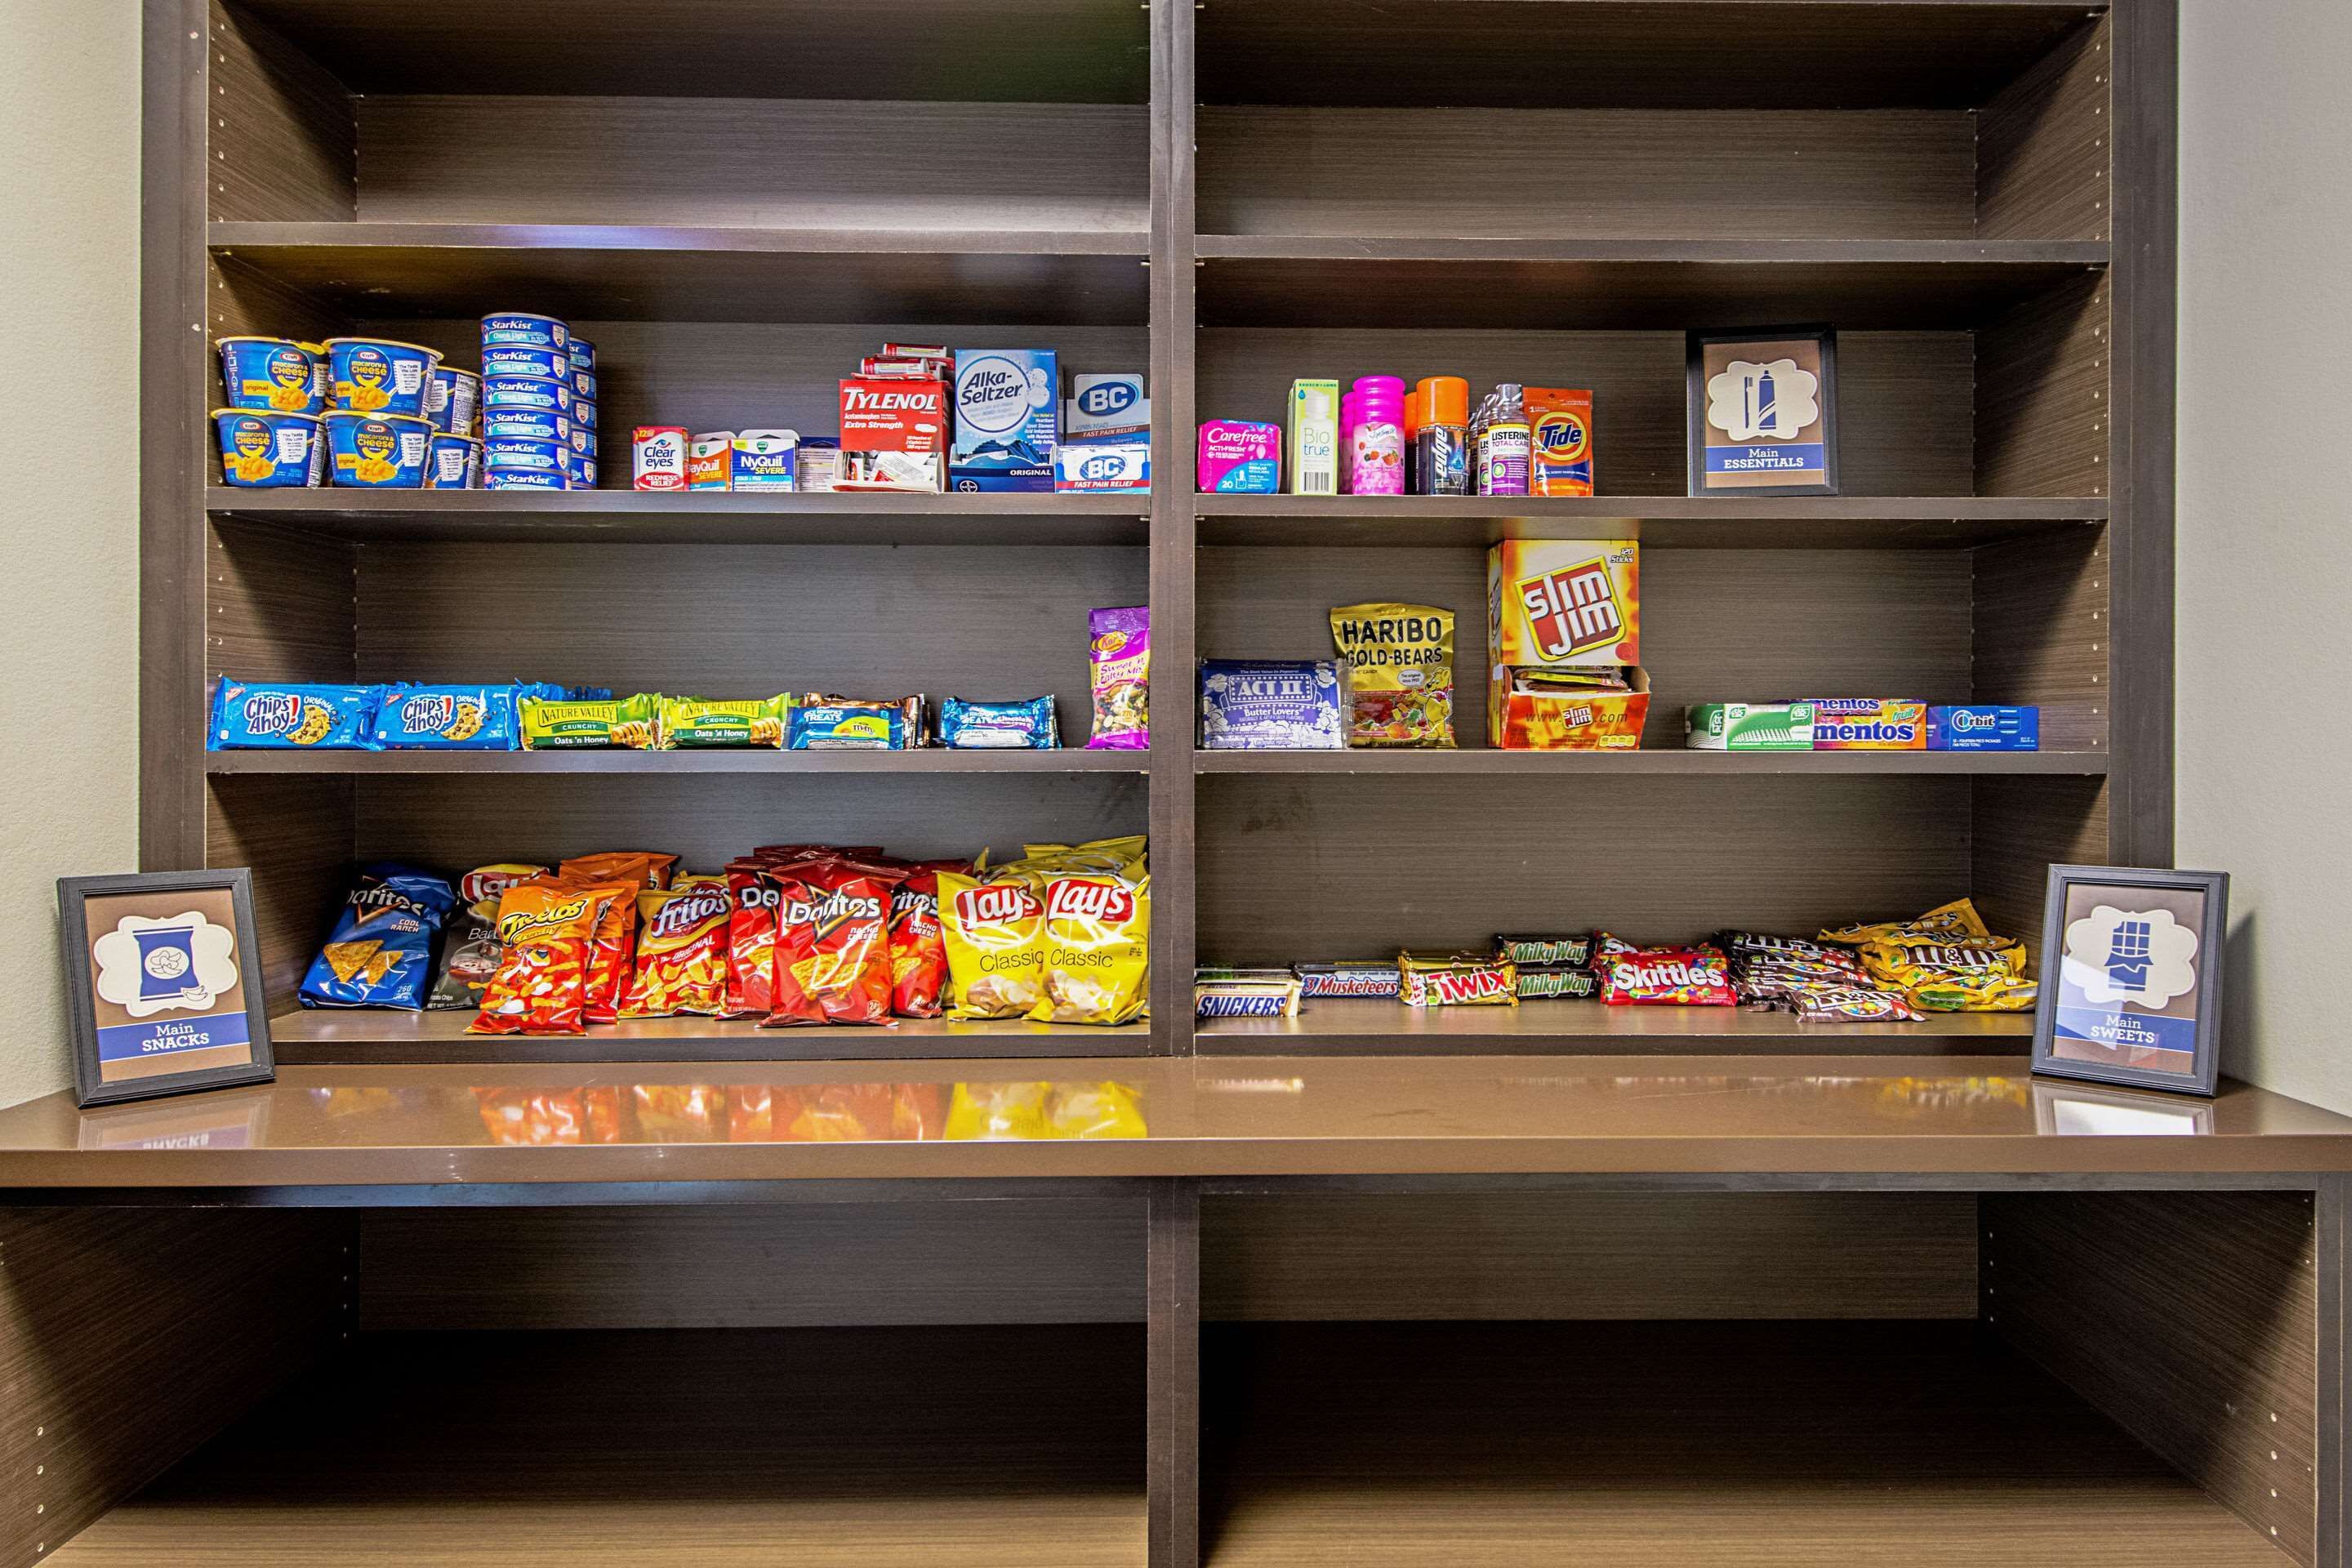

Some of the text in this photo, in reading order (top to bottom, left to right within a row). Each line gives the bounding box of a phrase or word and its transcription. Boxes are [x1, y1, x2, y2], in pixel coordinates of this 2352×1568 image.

[492, 320, 532, 330] StarKist
[492, 351, 532, 361] StarKist
[497, 382, 539, 392] StarKist
[964, 371, 1012, 390] Alka-
[960, 383, 1023, 406] Seltzer
[1089, 386, 1128, 412] BC
[496, 413, 537, 423] StarKist
[868, 421, 903, 430] Strength
[1208, 427, 1267, 445] Carefree
[1304, 427, 1330, 443] Bio
[1539, 423, 1583, 452] Tide
[496, 443, 537, 453] StarKist
[644, 447, 675, 457] Clear
[1304, 444, 1330, 456] true
[1748, 448, 1779, 458] Main
[646, 458, 673, 470] eyes
[741, 456, 784, 470] NyQuil
[1088, 458, 1120, 479] BC
[1724, 457, 1804, 469] ESSENTIALS
[507, 474, 550, 484] StarKist
[699, 470, 723, 479] SEVERE
[1342, 617, 1442, 644] HARIBO
[1346, 648, 1443, 667] GOLD-BEARS
[1238, 680, 1303, 696] ACT II
[246, 696, 291, 719] Chips
[403, 698, 443, 721] Chips
[541, 706, 614, 724] NATURE VALLEY
[724, 702, 757, 715] VALLEY
[1244, 707, 1299, 717] Butter Lovers
[562, 723, 597, 731] CRUNCHY
[1952, 710, 1996, 733] Orbit
[724, 729, 749, 738] Honey
[1814, 721, 1913, 740] mentos
[584, 736, 608, 746] Honey
[789, 897, 881, 924] Doritos
[390, 924, 419, 933] RANCH
[909, 927, 937, 938] CHEESE
[980, 949, 1044, 972] Classic
[1050, 949, 1113, 968] Classic
[1615, 963, 1726, 991] Skittles
[1304, 977, 1315, 991] 3
[1316, 976, 1397, 995] Musketeers
[1198, 996, 1286, 1016] SNICKERS
[156, 1023, 194, 1036] Main
[2106, 1014, 2141, 1030] Main
[142, 1032, 210, 1052] SNACKS
[2090, 1026, 2155, 1044] SWEETS
